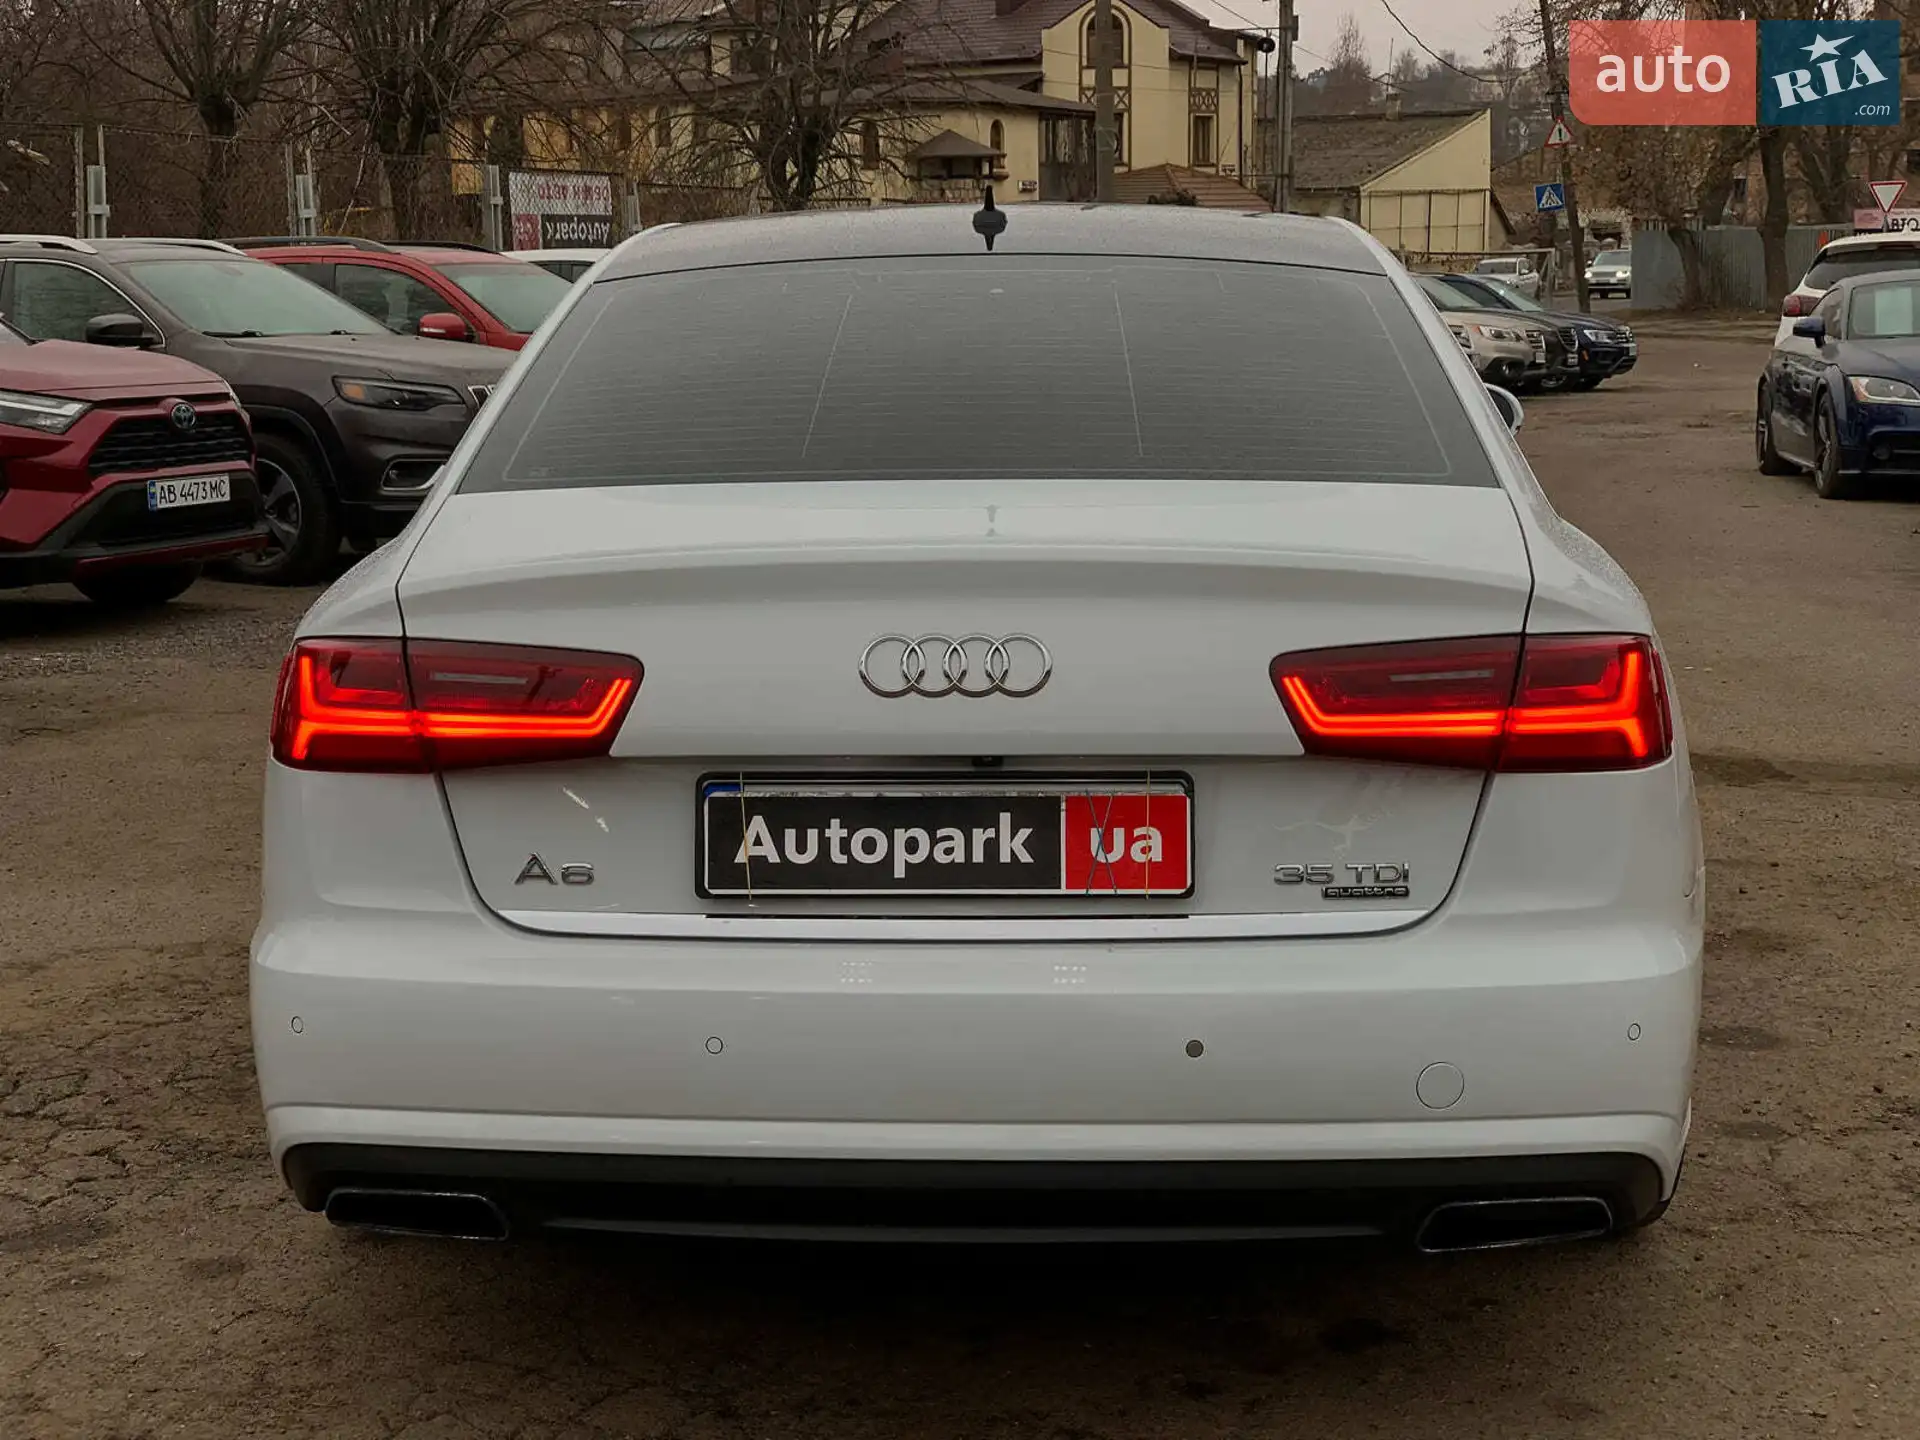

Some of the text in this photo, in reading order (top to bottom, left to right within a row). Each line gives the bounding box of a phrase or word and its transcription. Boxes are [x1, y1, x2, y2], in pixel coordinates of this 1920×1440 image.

[546, 217, 610, 245] Autopark
[180, 481, 208, 501] 4473
[733, 812, 1163, 878] Autopark ua
[514, 852, 595, 886] A6
[1273, 862, 1410, 885] 35 TDI
[1325, 887, 1407, 898] quattro
